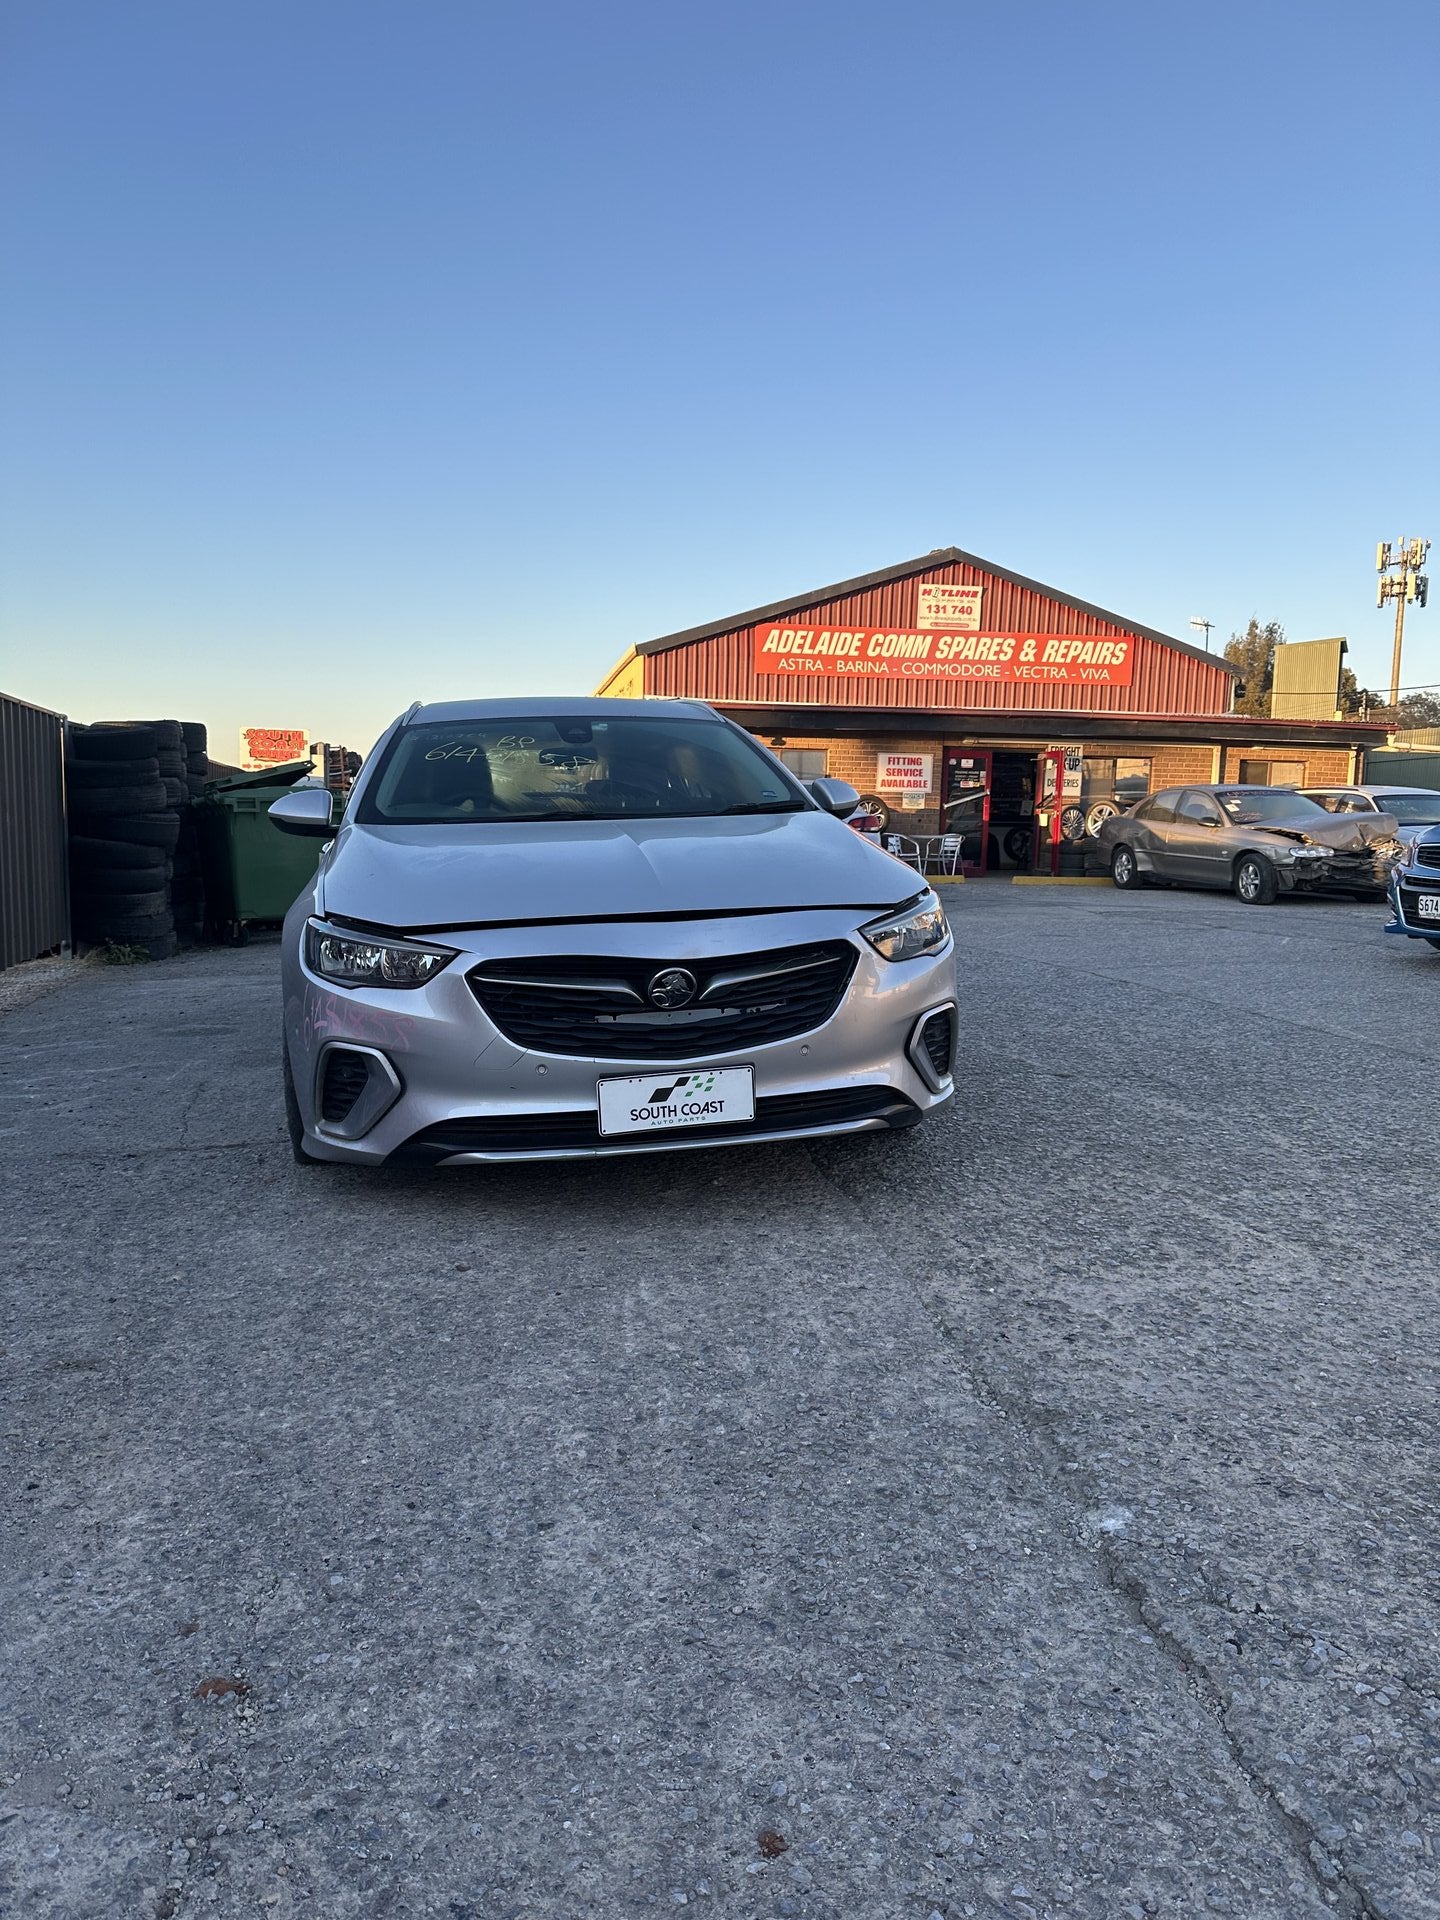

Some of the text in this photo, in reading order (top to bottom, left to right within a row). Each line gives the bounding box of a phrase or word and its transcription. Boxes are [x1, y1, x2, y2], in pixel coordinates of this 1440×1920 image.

[926, 604, 973, 616] 131 740
[762, 629, 1128, 666] ADELAIDE COMM SPARES & REPAIRS
[778, 658, 824, 671] ASTRA
[836, 660, 889, 674] BARINA
[901, 662, 1001, 678] COMMODORE
[1013, 665, 1068, 679] VECTRA
[1079, 667, 1110, 681] VIVA
[243, 729, 303, 740] SOUTH
[248, 739, 305, 750] COAST
[888, 756, 922, 766] FITTING
[885, 768, 923, 777] SERVICE
[880, 779, 928, 788] AVAILABLE
[1047, 778, 1079, 788] DEERIES
[1419, 899, 1439, 912] S674
[630, 1100, 725, 1121] SOUTH COAST
